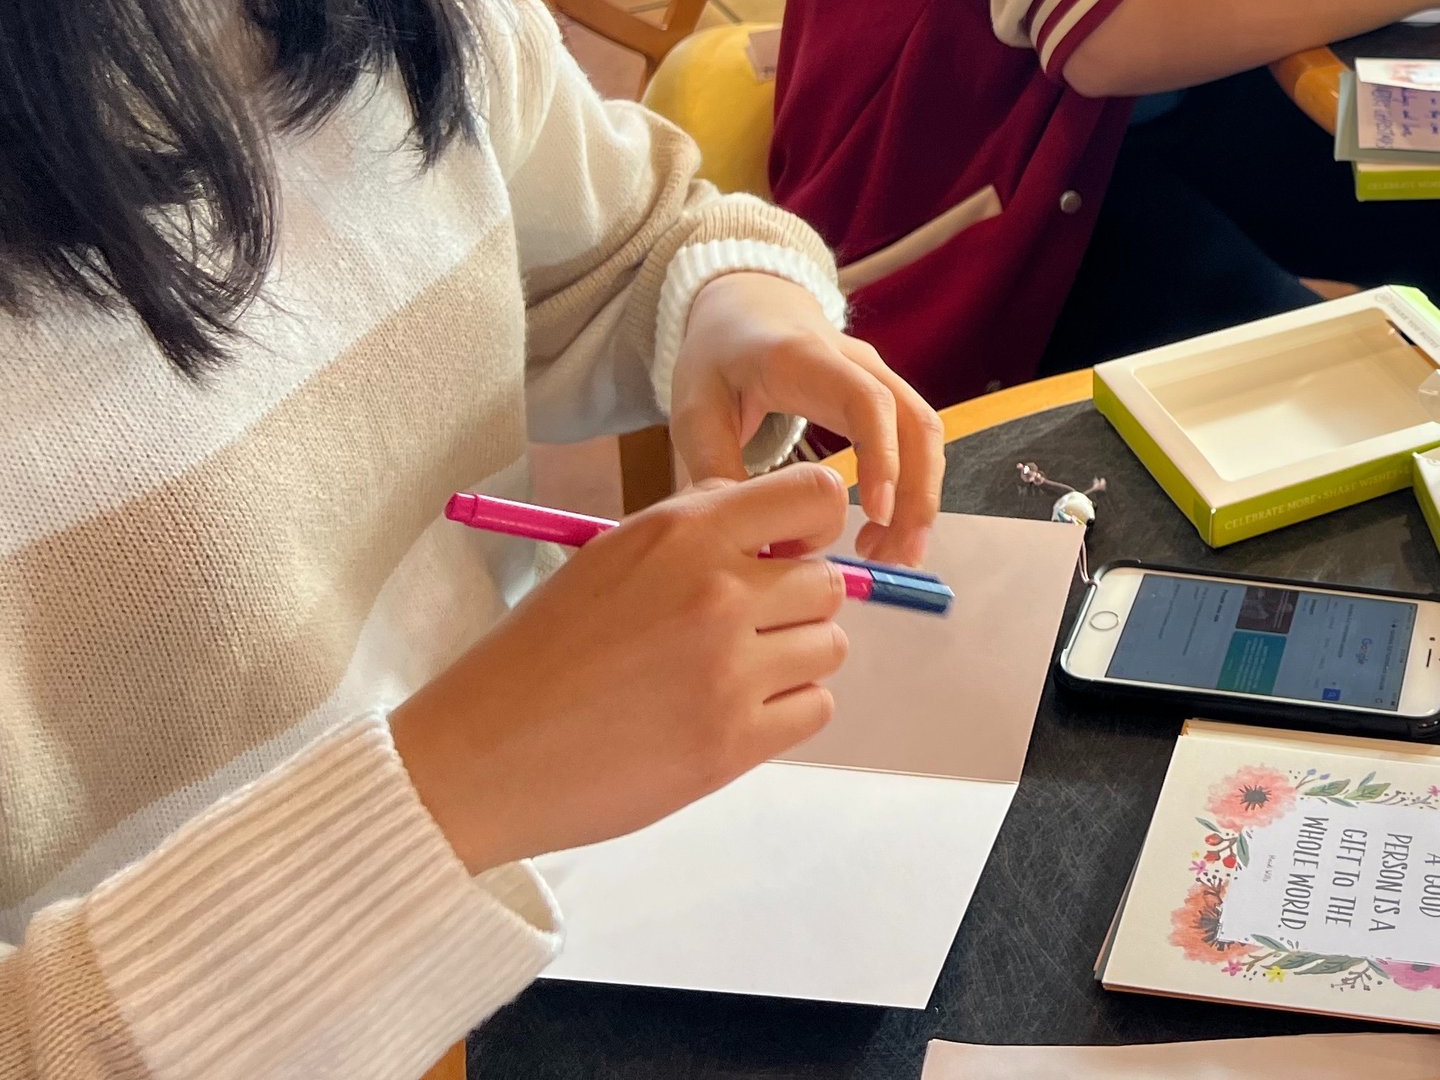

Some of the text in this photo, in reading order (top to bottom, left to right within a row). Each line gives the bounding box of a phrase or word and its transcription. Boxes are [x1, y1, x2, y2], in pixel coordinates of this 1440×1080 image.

[1224, 504, 1285, 531] CELEBRATE
[1286, 493, 1317, 514] MORE
[1277, 816, 1330, 931] WHOLE WORLD.
[1325, 828, 1368, 928] GIFT TO THE
[1368, 832, 1413, 932] PERSON IS A
